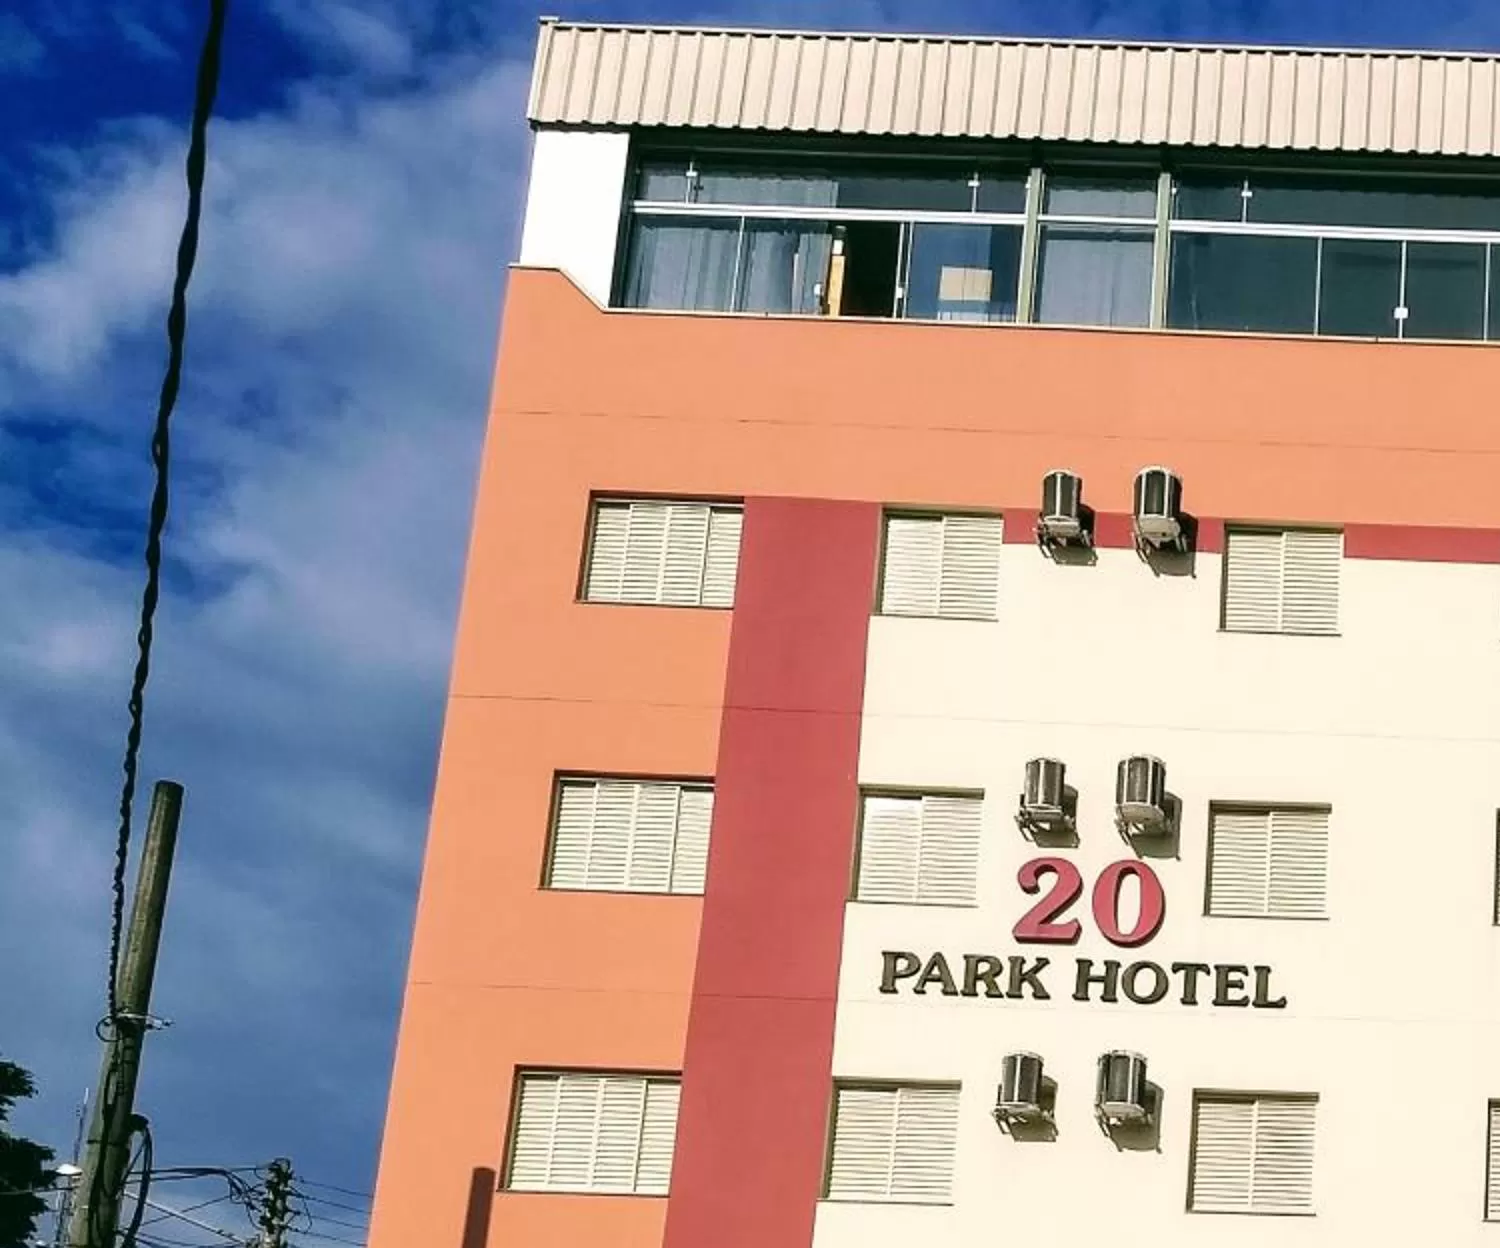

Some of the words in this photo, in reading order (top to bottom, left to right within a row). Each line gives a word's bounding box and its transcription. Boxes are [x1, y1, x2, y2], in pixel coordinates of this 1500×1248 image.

[1012, 857, 1166, 948] 20
[879, 950, 1051, 1000] PARK
[1071, 958, 1287, 1009] HOTEL
